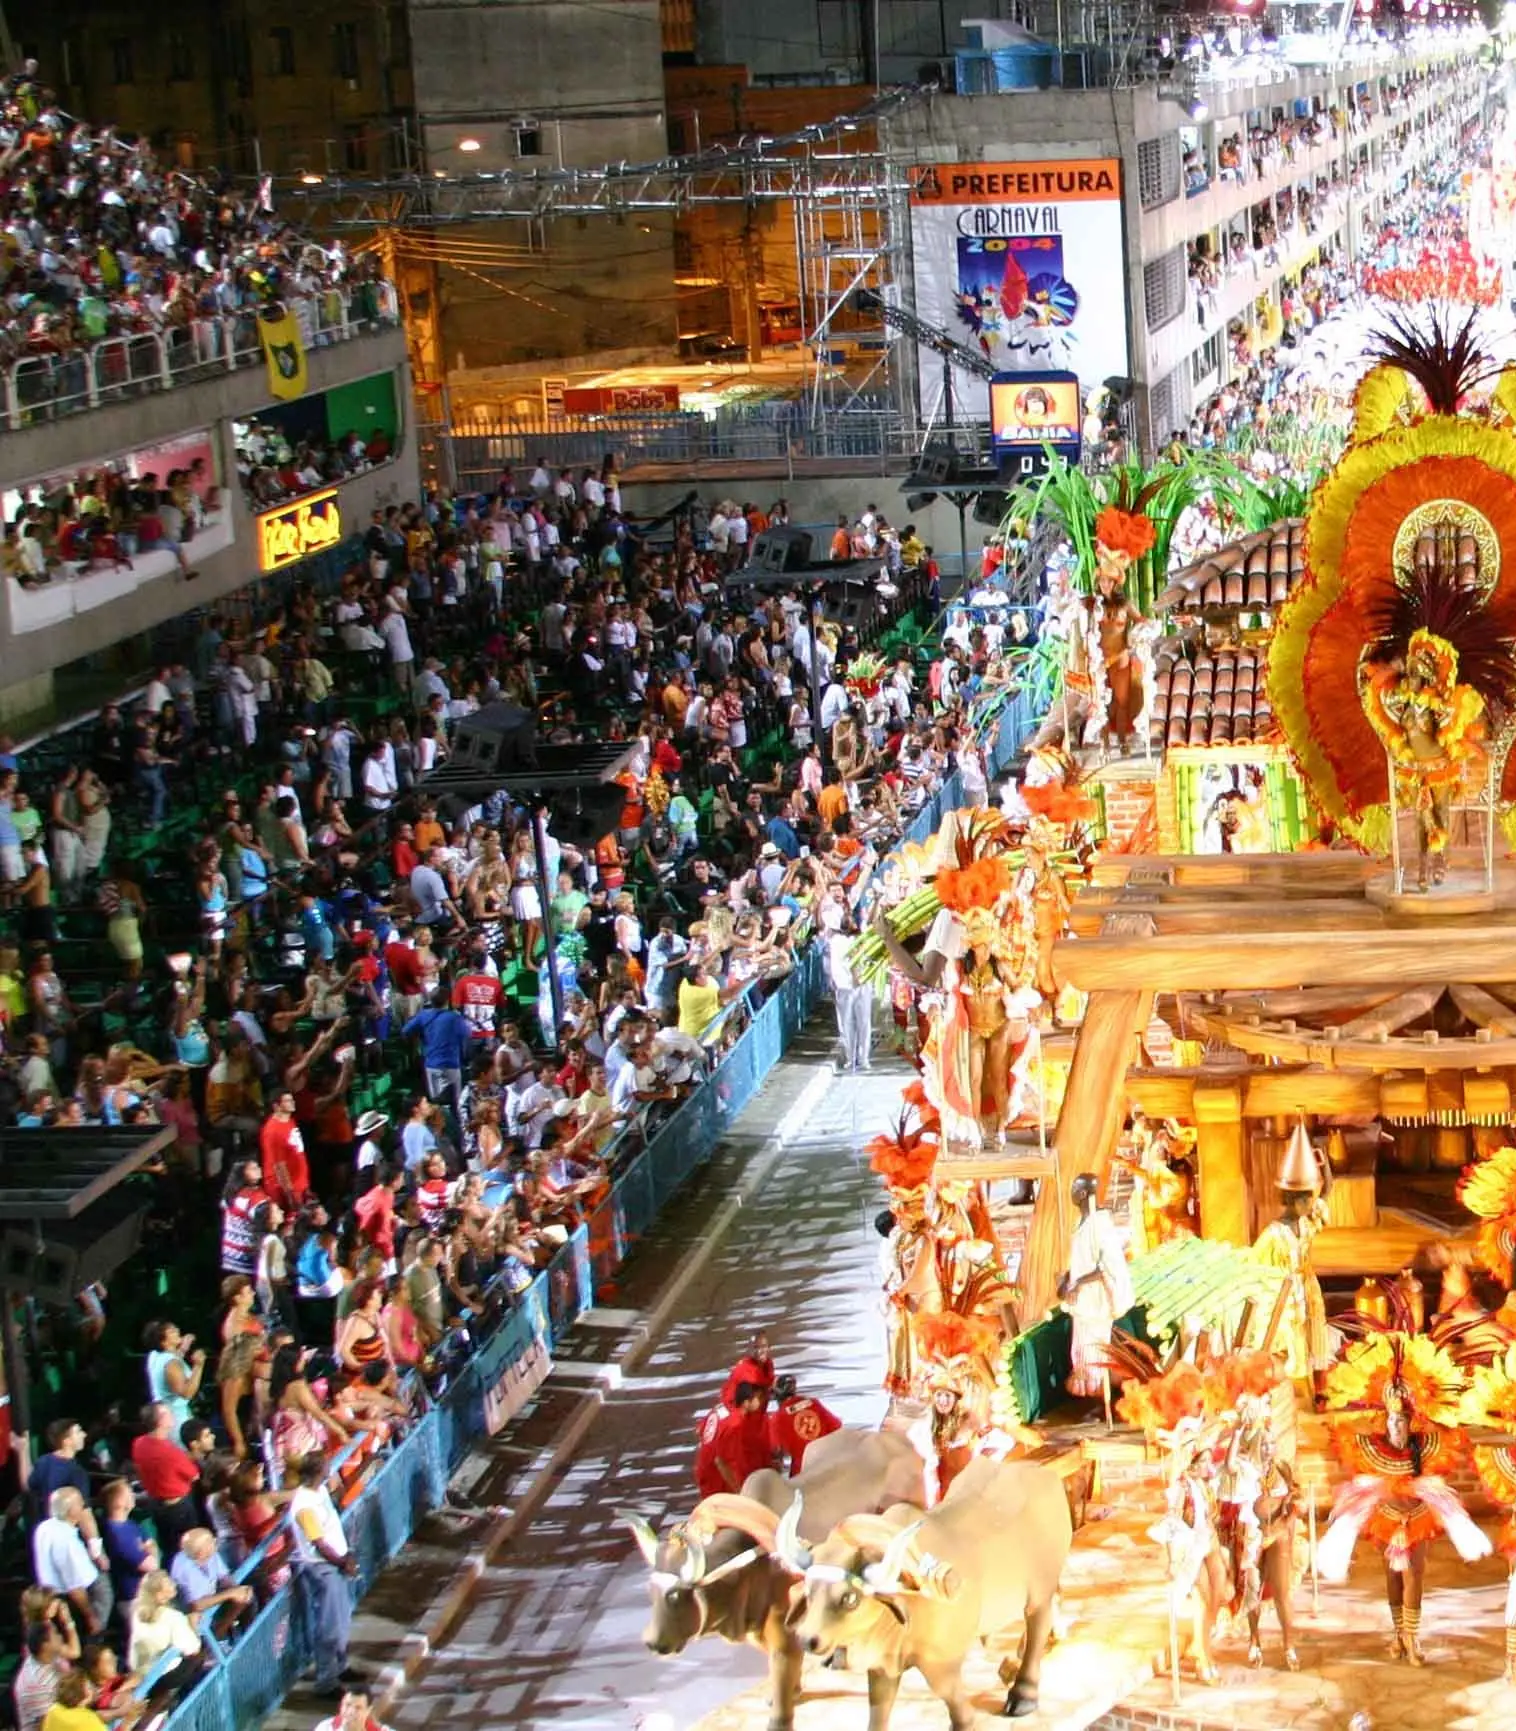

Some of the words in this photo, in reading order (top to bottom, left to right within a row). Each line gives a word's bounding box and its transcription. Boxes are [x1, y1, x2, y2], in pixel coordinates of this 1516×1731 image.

[952, 170, 1114, 195] PREFEITURA
[957, 206, 1063, 237] CARNAVAL
[966, 238, 1056, 253] 2004
